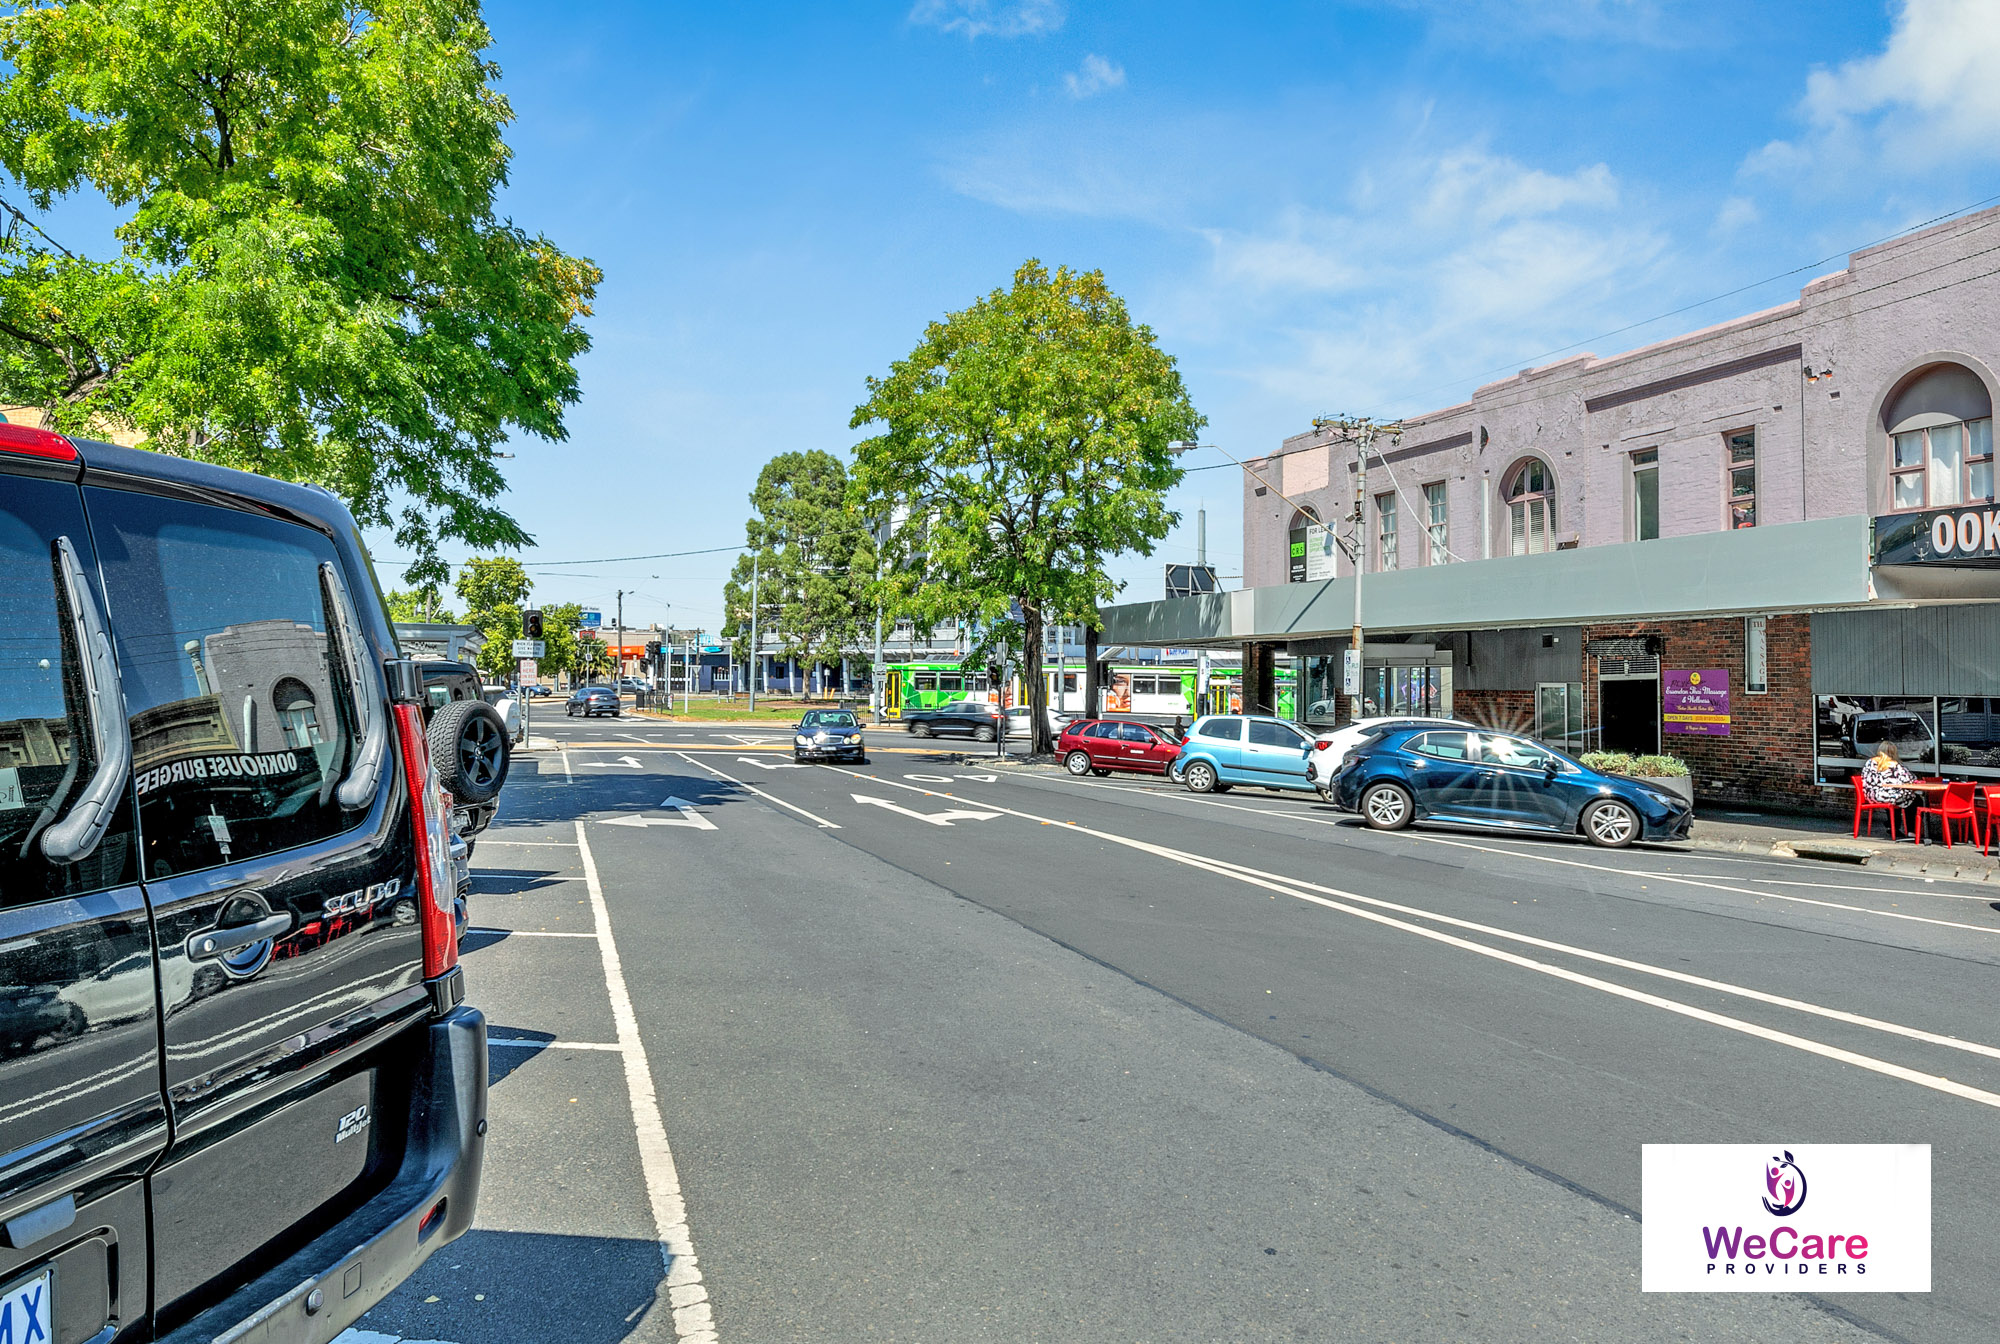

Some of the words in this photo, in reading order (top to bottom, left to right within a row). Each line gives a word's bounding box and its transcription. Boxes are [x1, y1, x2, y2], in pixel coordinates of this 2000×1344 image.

[1931, 511, 2000, 554] OOK
[1702, 686, 1727, 698] Massage
[321, 878, 400, 919] SCUDO
[337, 1104, 367, 1132] 120
